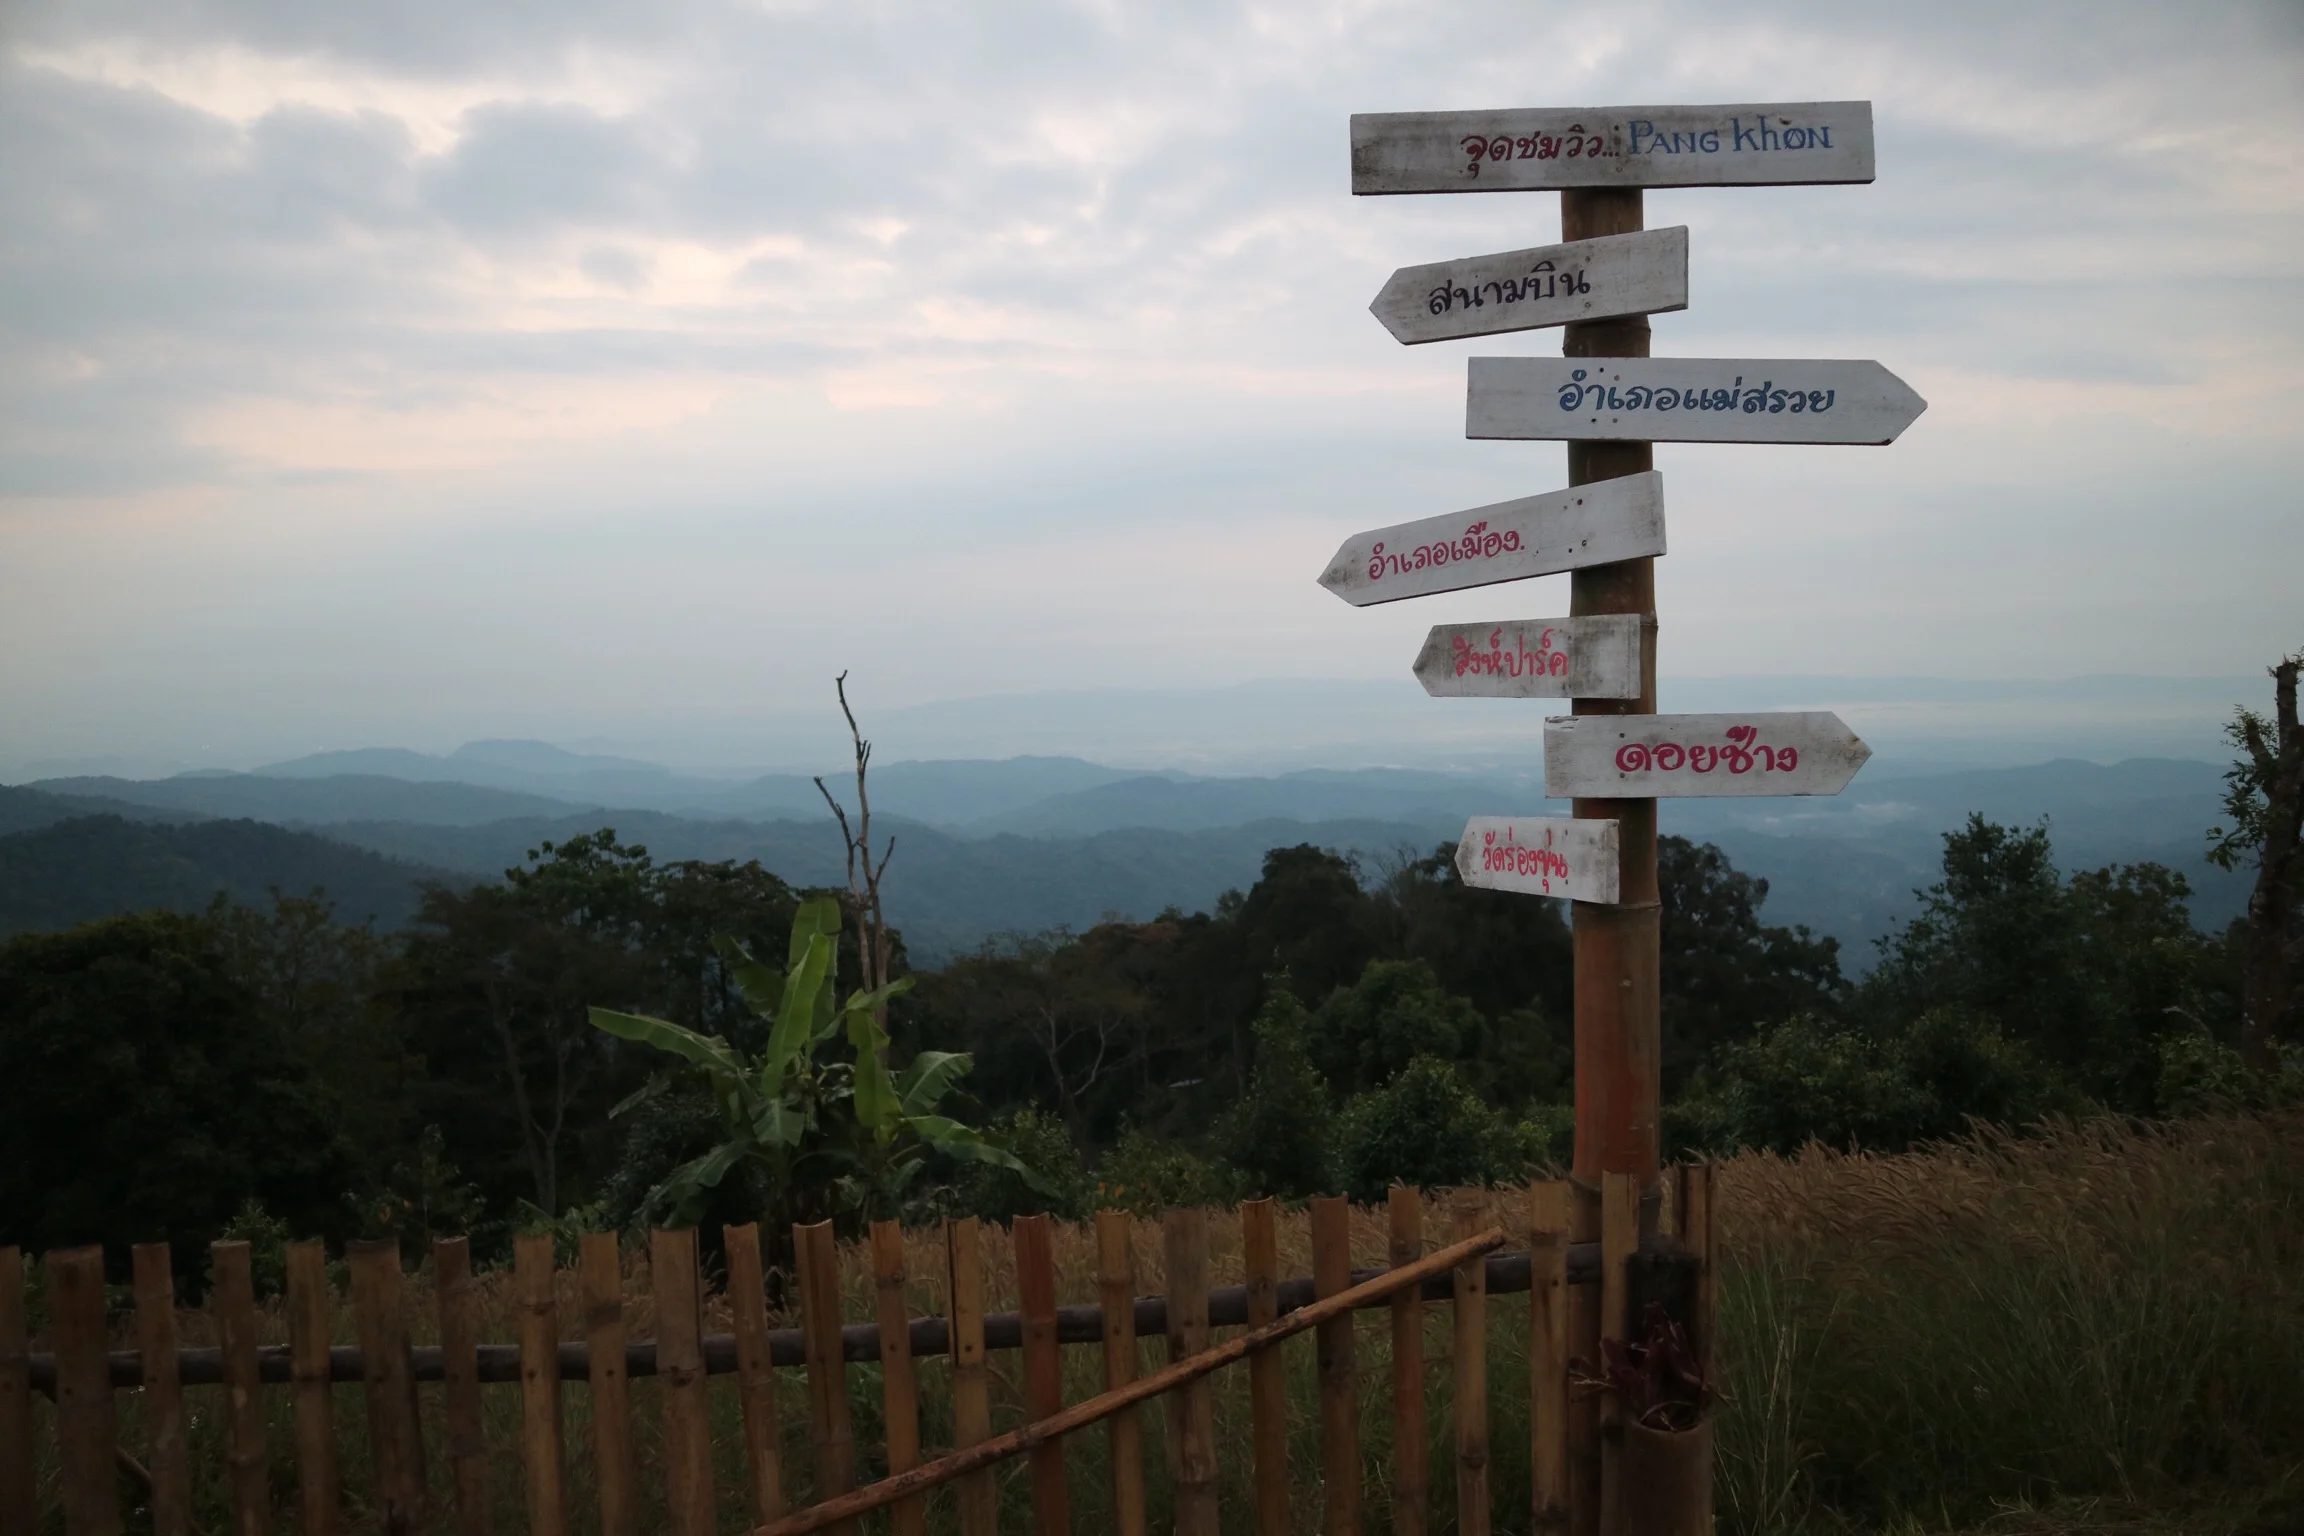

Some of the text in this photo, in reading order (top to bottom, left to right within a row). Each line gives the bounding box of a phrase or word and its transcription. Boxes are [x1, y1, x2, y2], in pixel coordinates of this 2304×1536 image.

[1627, 120, 1720, 154] PANG
[1429, 260, 1591, 316] สนามบิน
[1558, 369, 1835, 414] อำเภอแม่สรวย
[1452, 628, 1568, 677] สิงห์ปาร์ค
[1615, 725, 1798, 774] ดอยช้าง
[1482, 826, 1569, 894] วัดร่องขุ่น
